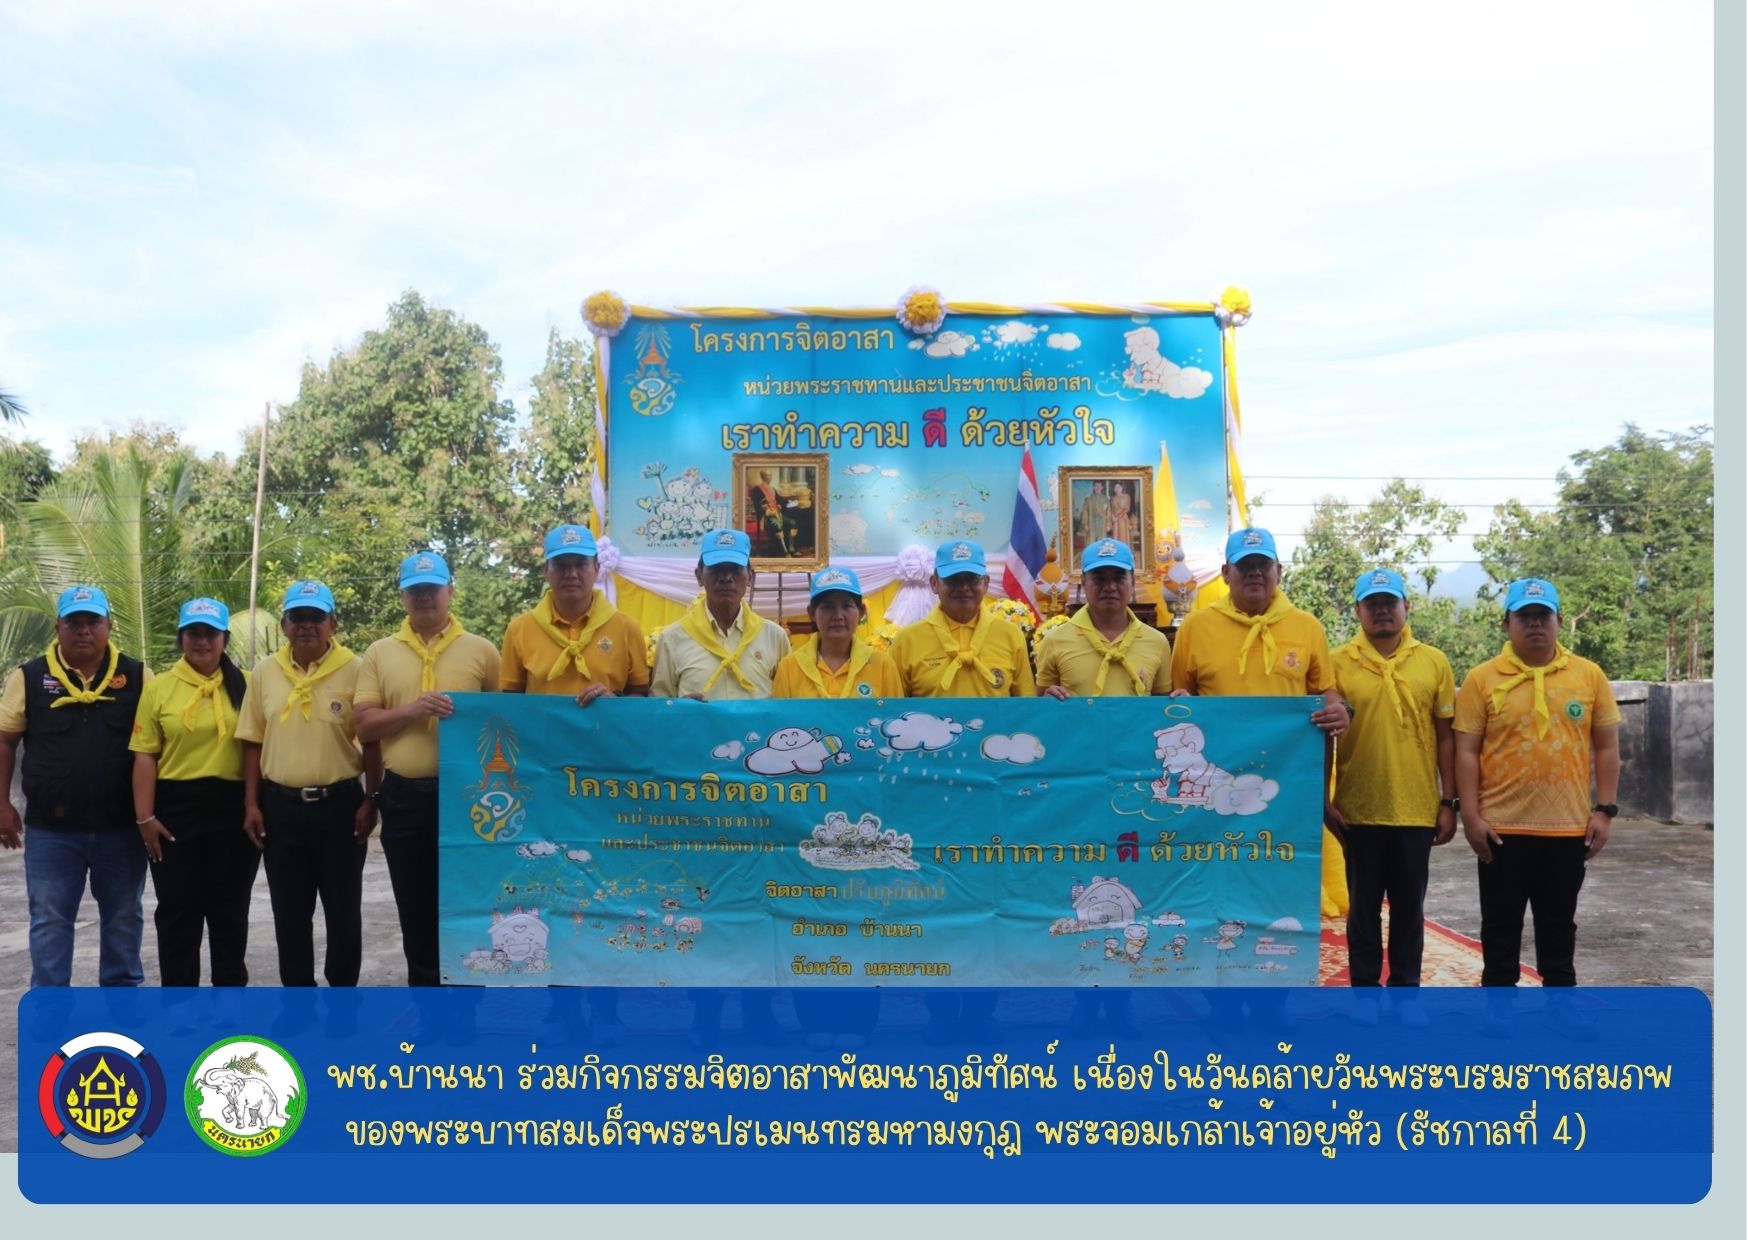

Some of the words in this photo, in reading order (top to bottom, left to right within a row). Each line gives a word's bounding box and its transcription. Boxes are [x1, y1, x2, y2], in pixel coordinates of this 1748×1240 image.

[690, 322, 895, 353] โครงการจิตอาสา
[743, 371, 1092, 396] หน่วยพระราชทานและประชาชนจิตอาสา
[721, 409, 910, 450] เราทำความ
[922, 407, 947, 448] ดี
[960, 405, 1115, 448] ด้วยหัวใจ
[563, 766, 829, 803] โครงการจิตอาสา
[616, 808, 772, 829] หน่วยพระราชทาน
[934, 836, 1107, 864] เราทำความ
[1116, 830, 1141, 863] ดี
[1150, 830, 1296, 863] ด้วยหัวใจ
[765, 880, 838, 900] จิตอาสา
[791, 917, 849, 937] อำเภอ
[860, 918, 923, 938] บ้านนา
[791, 956, 853, 976] จังหวัด
[863, 960, 951, 977] นครนายก
